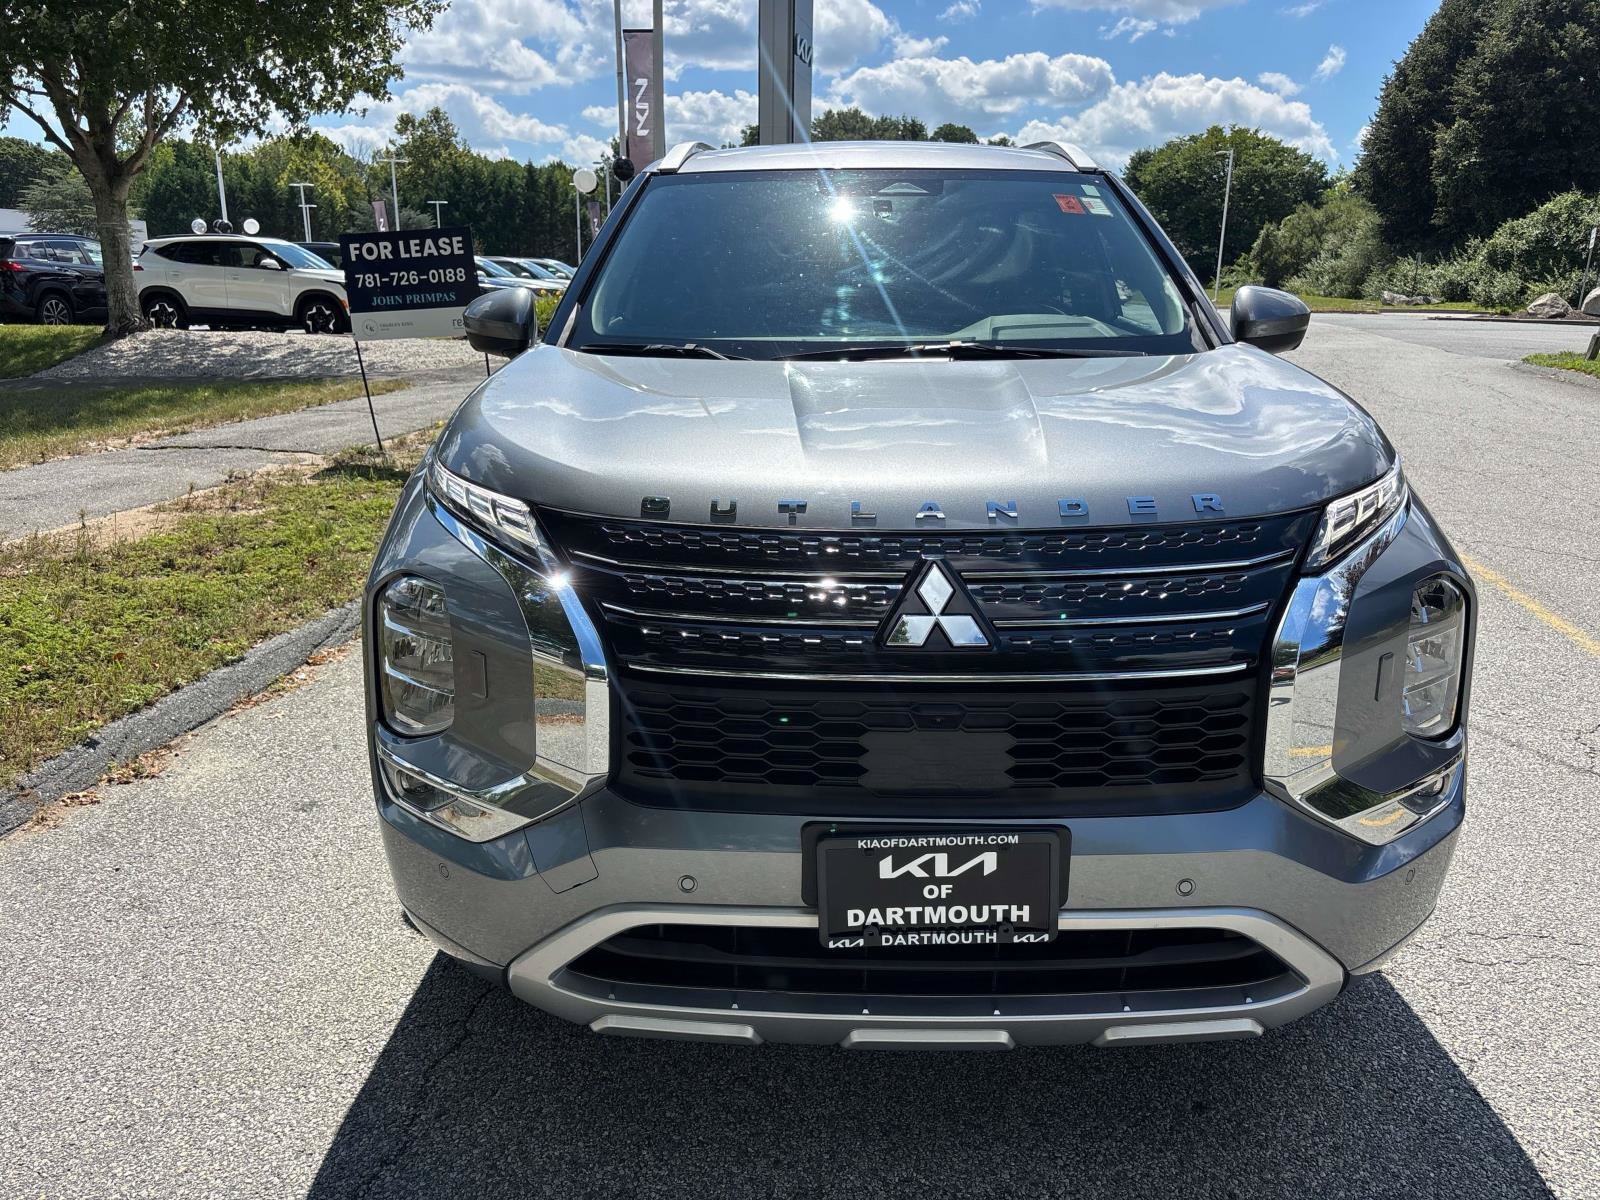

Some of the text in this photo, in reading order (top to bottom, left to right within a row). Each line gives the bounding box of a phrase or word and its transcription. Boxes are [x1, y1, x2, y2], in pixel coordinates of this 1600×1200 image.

[349, 236, 464, 261] FOR LEASE
[355, 267, 466, 288] 781-726-0188
[372, 291, 456, 306] JOHN PRIMPAS
[452, 318, 465, 327] re
[641, 493, 1224, 520] OUTLANDER
[857, 835, 1019, 849] KIAOFDARTMOUTH.COM
[879, 851, 997, 879] KIA
[923, 884, 953, 899] OF
[847, 905, 1030, 927] DARTMOUTH
[829, 932, 1049, 949] KIA DARTMOUTH KIA
